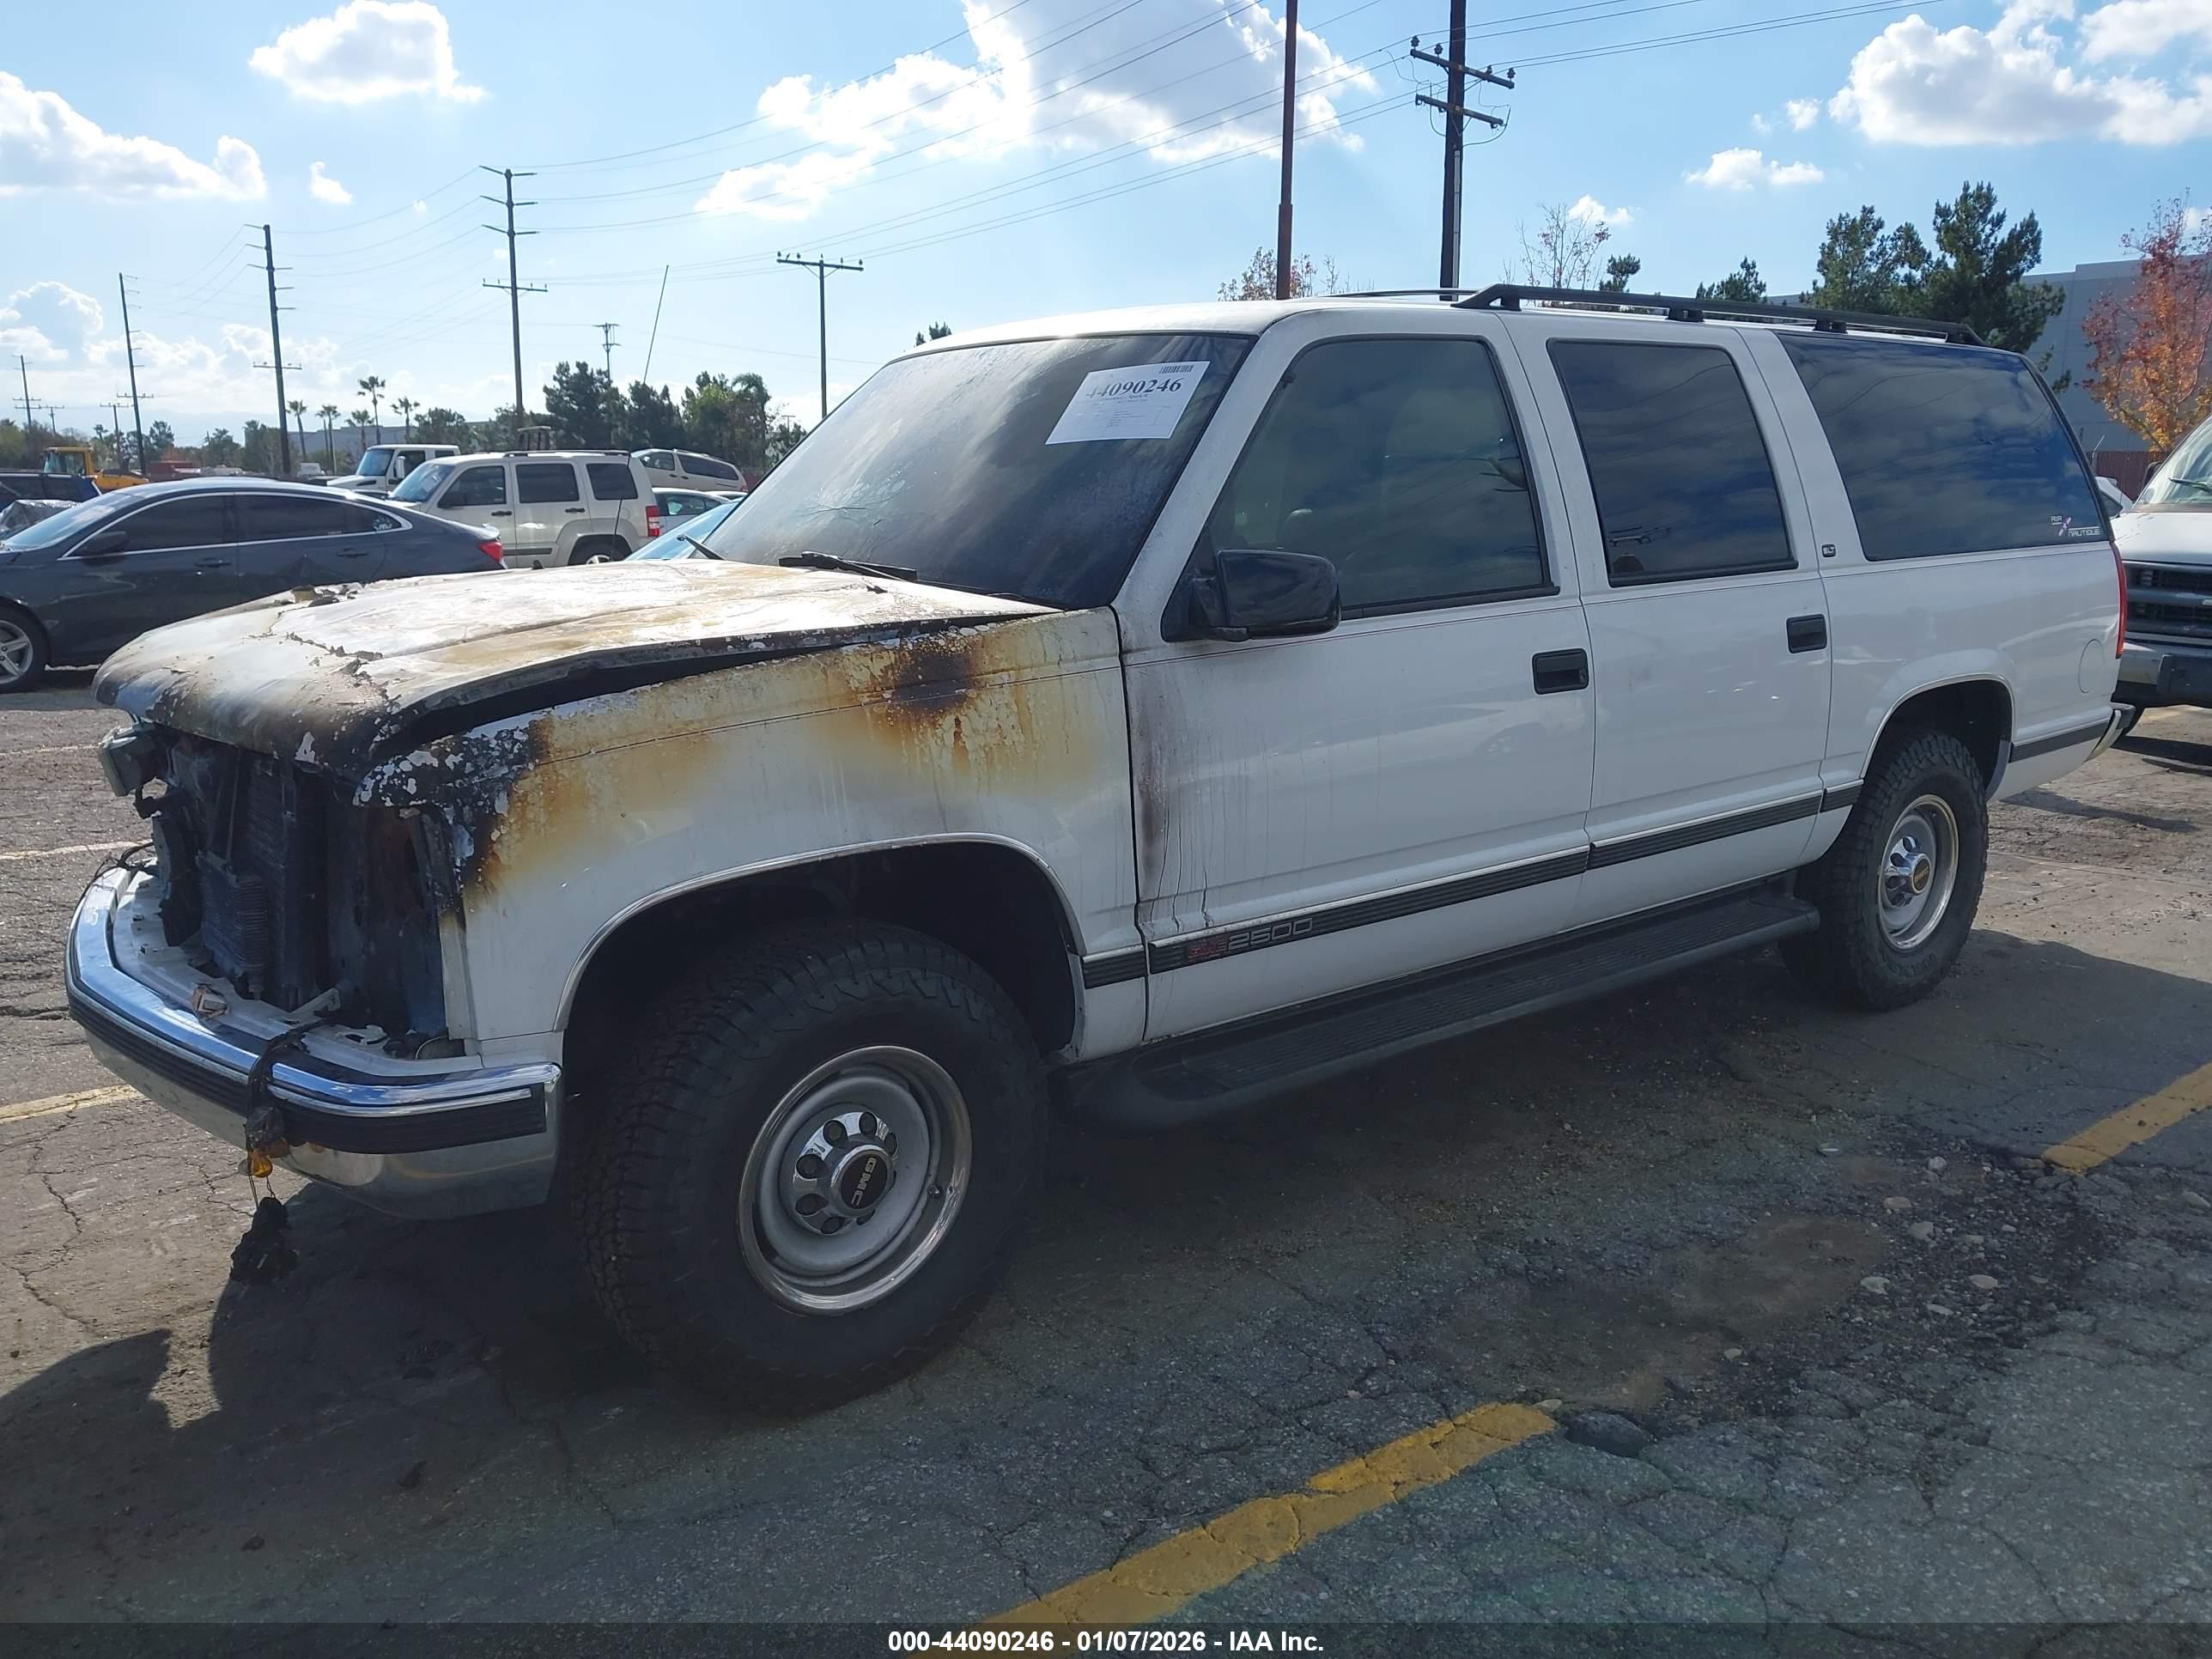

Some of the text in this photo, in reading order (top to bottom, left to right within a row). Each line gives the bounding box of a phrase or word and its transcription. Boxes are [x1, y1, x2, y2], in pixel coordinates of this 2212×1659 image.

[1085, 377, 1184, 398] 44090246
[1229, 917, 1313, 953] 2500
[851, 1157, 878, 1206] GMC
